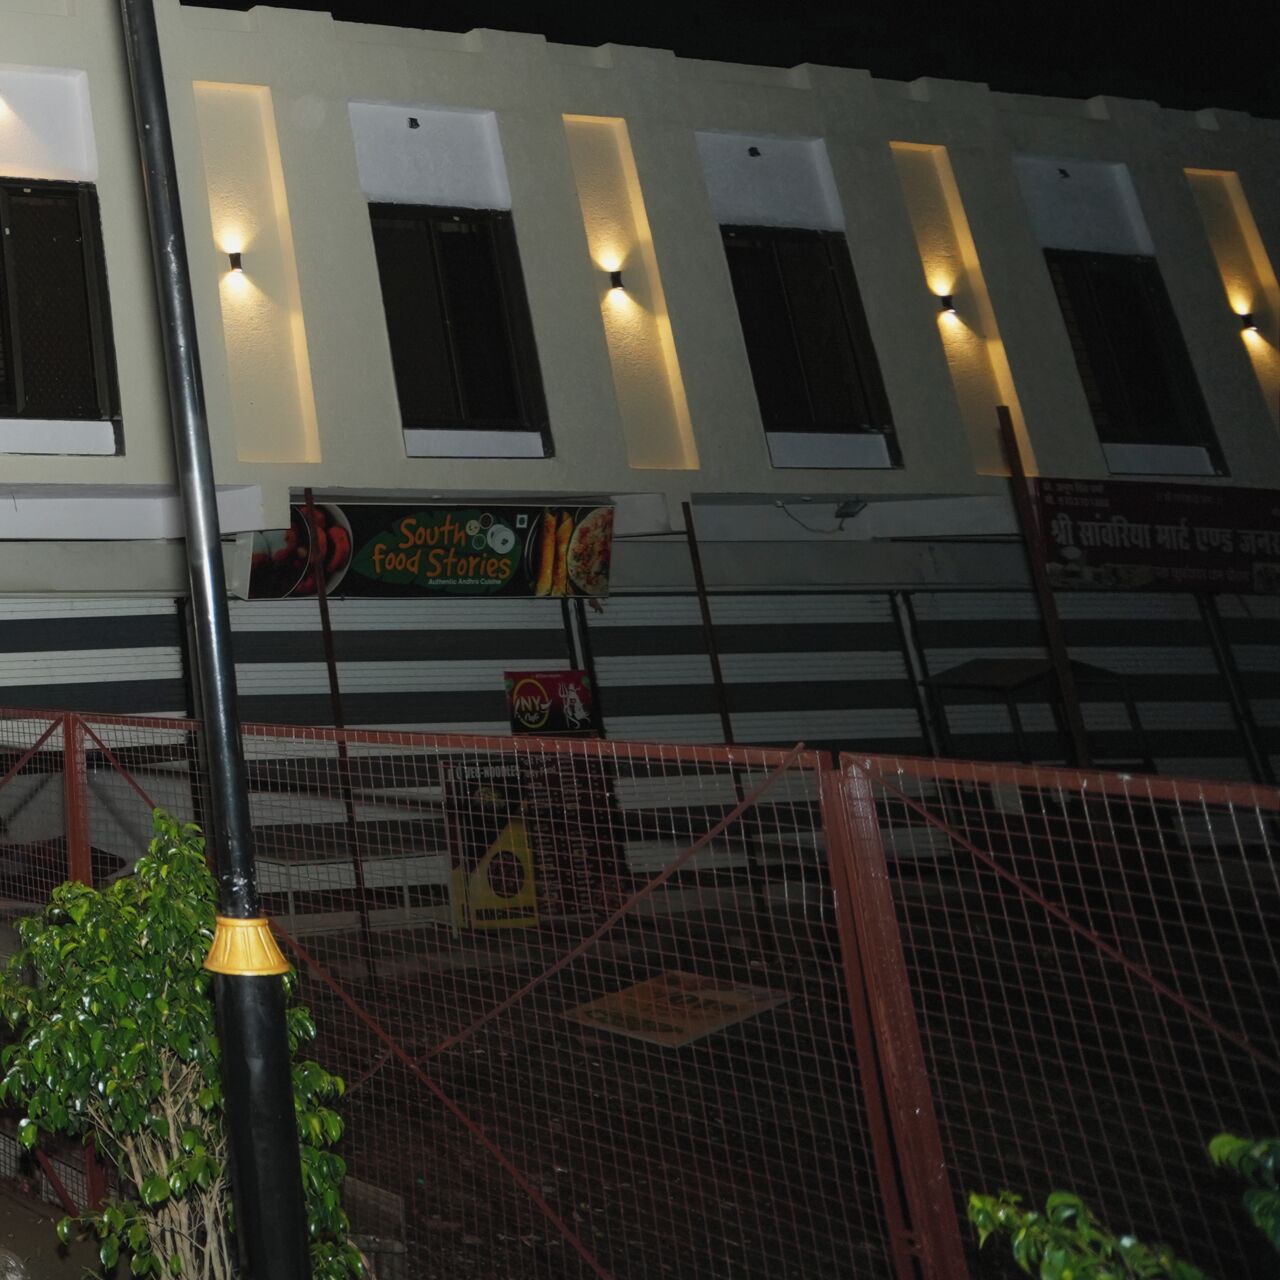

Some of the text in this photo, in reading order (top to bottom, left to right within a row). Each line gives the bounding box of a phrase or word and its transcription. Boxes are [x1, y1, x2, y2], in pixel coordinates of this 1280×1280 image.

[398, 514, 466, 549] South
[372, 543, 513, 578] food Stories
